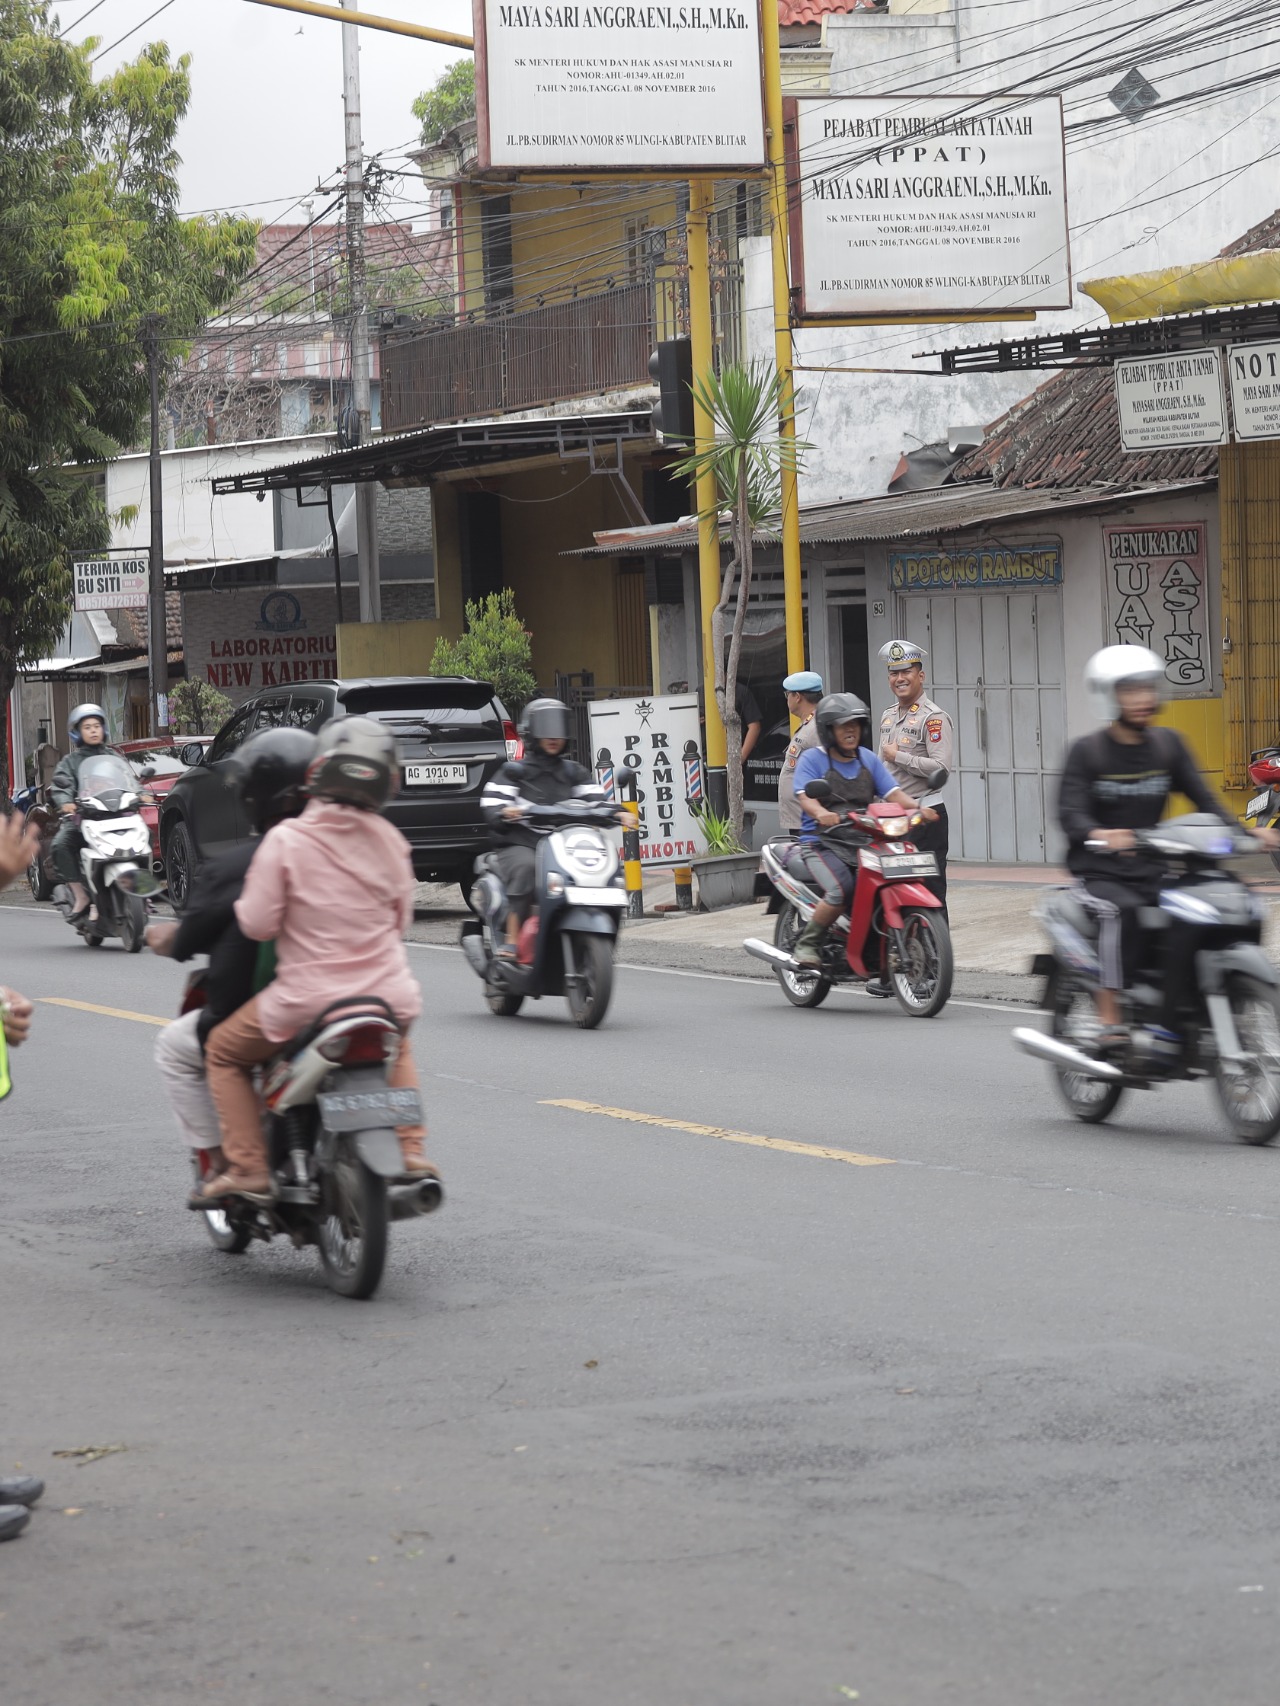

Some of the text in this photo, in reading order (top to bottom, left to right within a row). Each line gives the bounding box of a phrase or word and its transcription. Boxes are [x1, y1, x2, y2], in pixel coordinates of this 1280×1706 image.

[500, 6, 541, 28] MAYA
[544, 6, 578, 28] SARI
[514, 58, 732, 68] SK MENTERI HUKUM DAN HAK ASASI MANUSIA RI
[536, 84, 567, 92] TAHUN
[634, 84, 643, 92] 08
[645, 84, 696, 93] NOVEMBER
[698, 84, 716, 93] 2016
[824, 116, 1032, 138] PEJABAT PEMBUAT AKTA TANAH
[580, 134, 614, 146] NOMOR
[615, 134, 624, 146] 85
[715, 135, 747, 146] BLITAR
[812, 180, 852, 200] MAYA
[856, 178, 888, 199] SARI
[847, 239, 877, 247] TAHUN
[941, 238, 950, 246] 08
[952, 237, 1001, 245] NOVEMBER
[1003, 236, 1020, 244] 2016
[891, 278, 924, 289] NOMOR
[925, 277, 934, 288] 85
[1020, 274, 1051, 286] BLITAR
[1121, 357, 1214, 384] PEJABAT PEMBUAT AKTA TANAH
[1243, 386, 1257, 400] MAYA
[1258, 384, 1272, 399] SARI
[1110, 529, 1198, 558] PENUKARAN
[77, 561, 145, 576] TERIMA KOS
[906, 550, 1058, 586] POTONG RAMBUT
[78, 579, 94, 594] BU
[97, 577, 120, 593] SITI
[873, 603, 883, 614] 83
[1114, 563, 1154, 647] UAN
[1160, 560, 1205, 685] ASING
[211, 635, 336, 658] LABORATORIU
[207, 659, 337, 687] NEW KARTI
[901, 728, 917, 736] POLRI
[408, 767, 464, 778] AG 1916 PU
[651, 733, 675, 837] RAMBUT
[616, 840, 696, 861] MHKOTA
